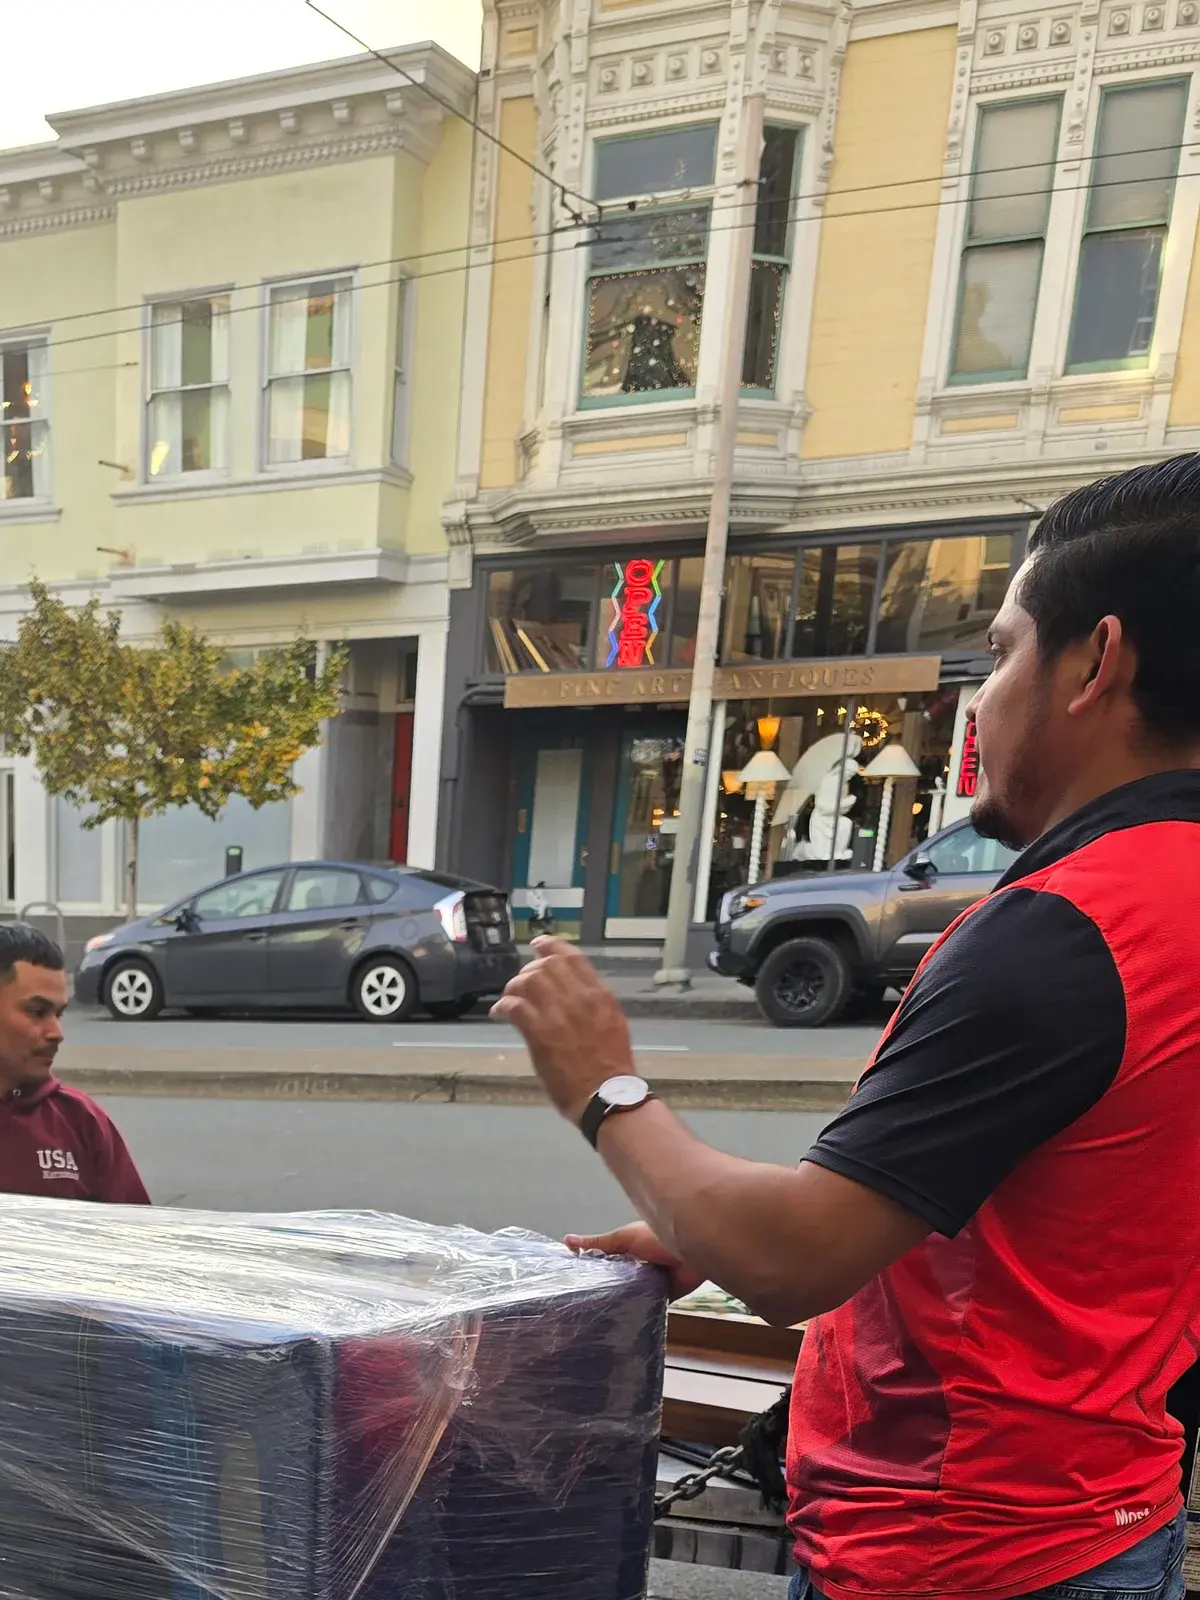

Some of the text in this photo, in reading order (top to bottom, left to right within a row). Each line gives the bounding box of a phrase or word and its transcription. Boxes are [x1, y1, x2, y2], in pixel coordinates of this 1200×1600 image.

[618, 559, 654, 667] OPEN
[560, 667, 876, 698] FINE ART ANTIQUES
[36, 1149, 79, 1171] USA
